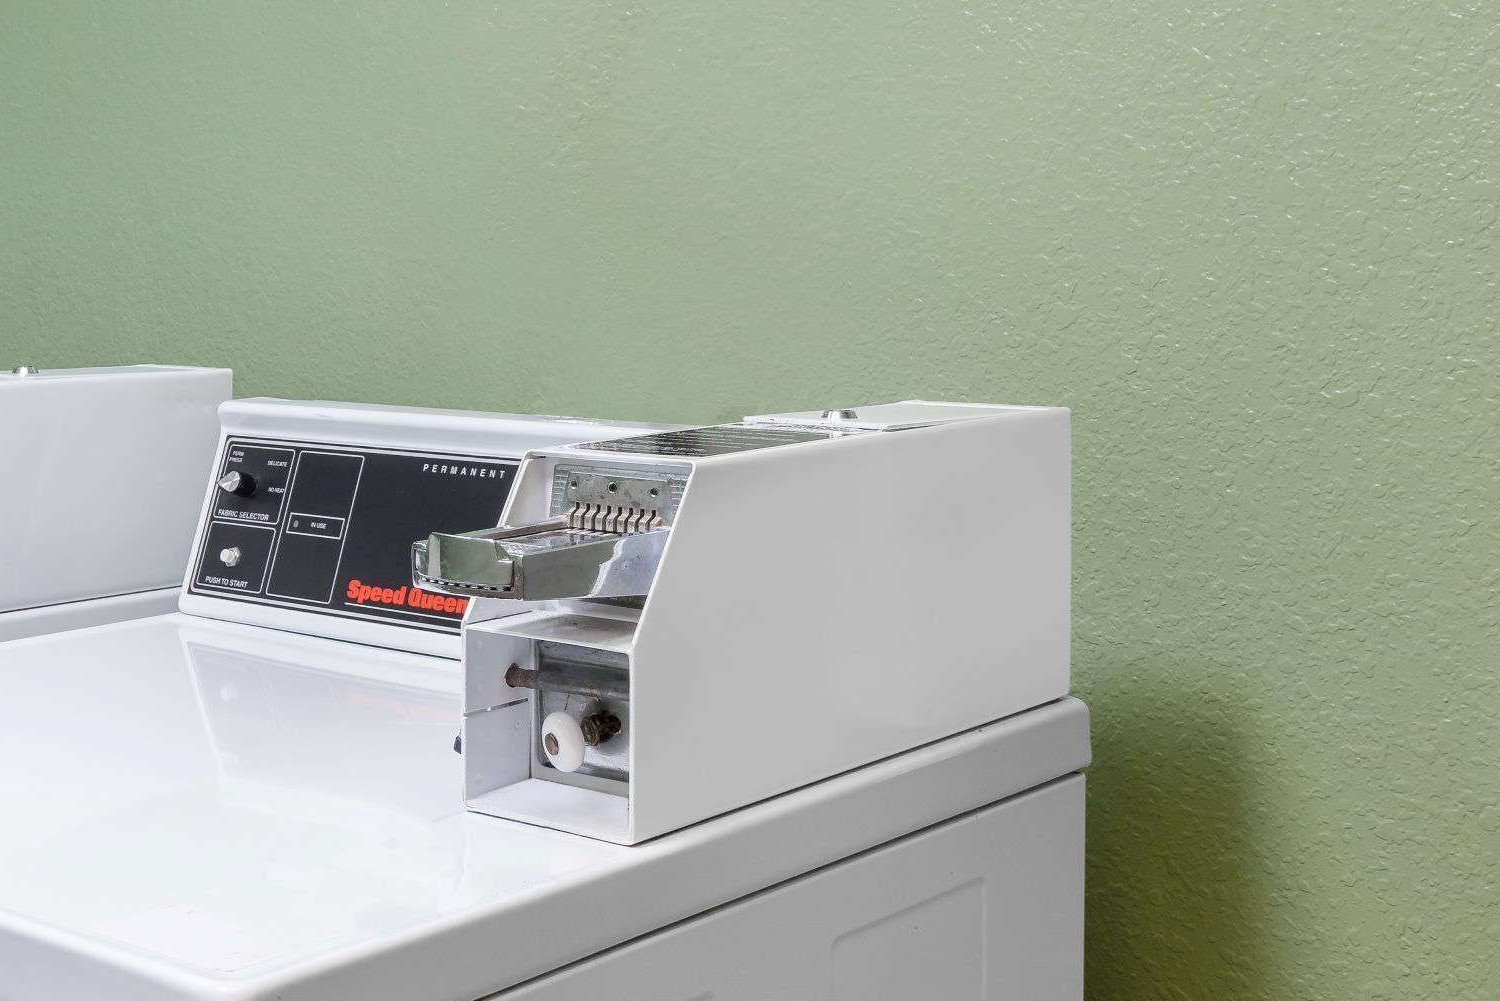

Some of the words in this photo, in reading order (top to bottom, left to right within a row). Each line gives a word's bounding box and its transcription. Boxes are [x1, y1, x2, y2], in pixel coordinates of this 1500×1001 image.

[267, 460, 288, 468] DELICATE
[422, 463, 506, 479] PERMANENT
[217, 508, 239, 518] FABRIC
[239, 511, 270, 521] SELECTOR
[205, 575, 220, 585] PUSH
[220, 577, 228, 586] TO
[229, 578, 249, 588] START
[347, 579, 407, 605] Speed
[408, 588, 470, 614] Queen
